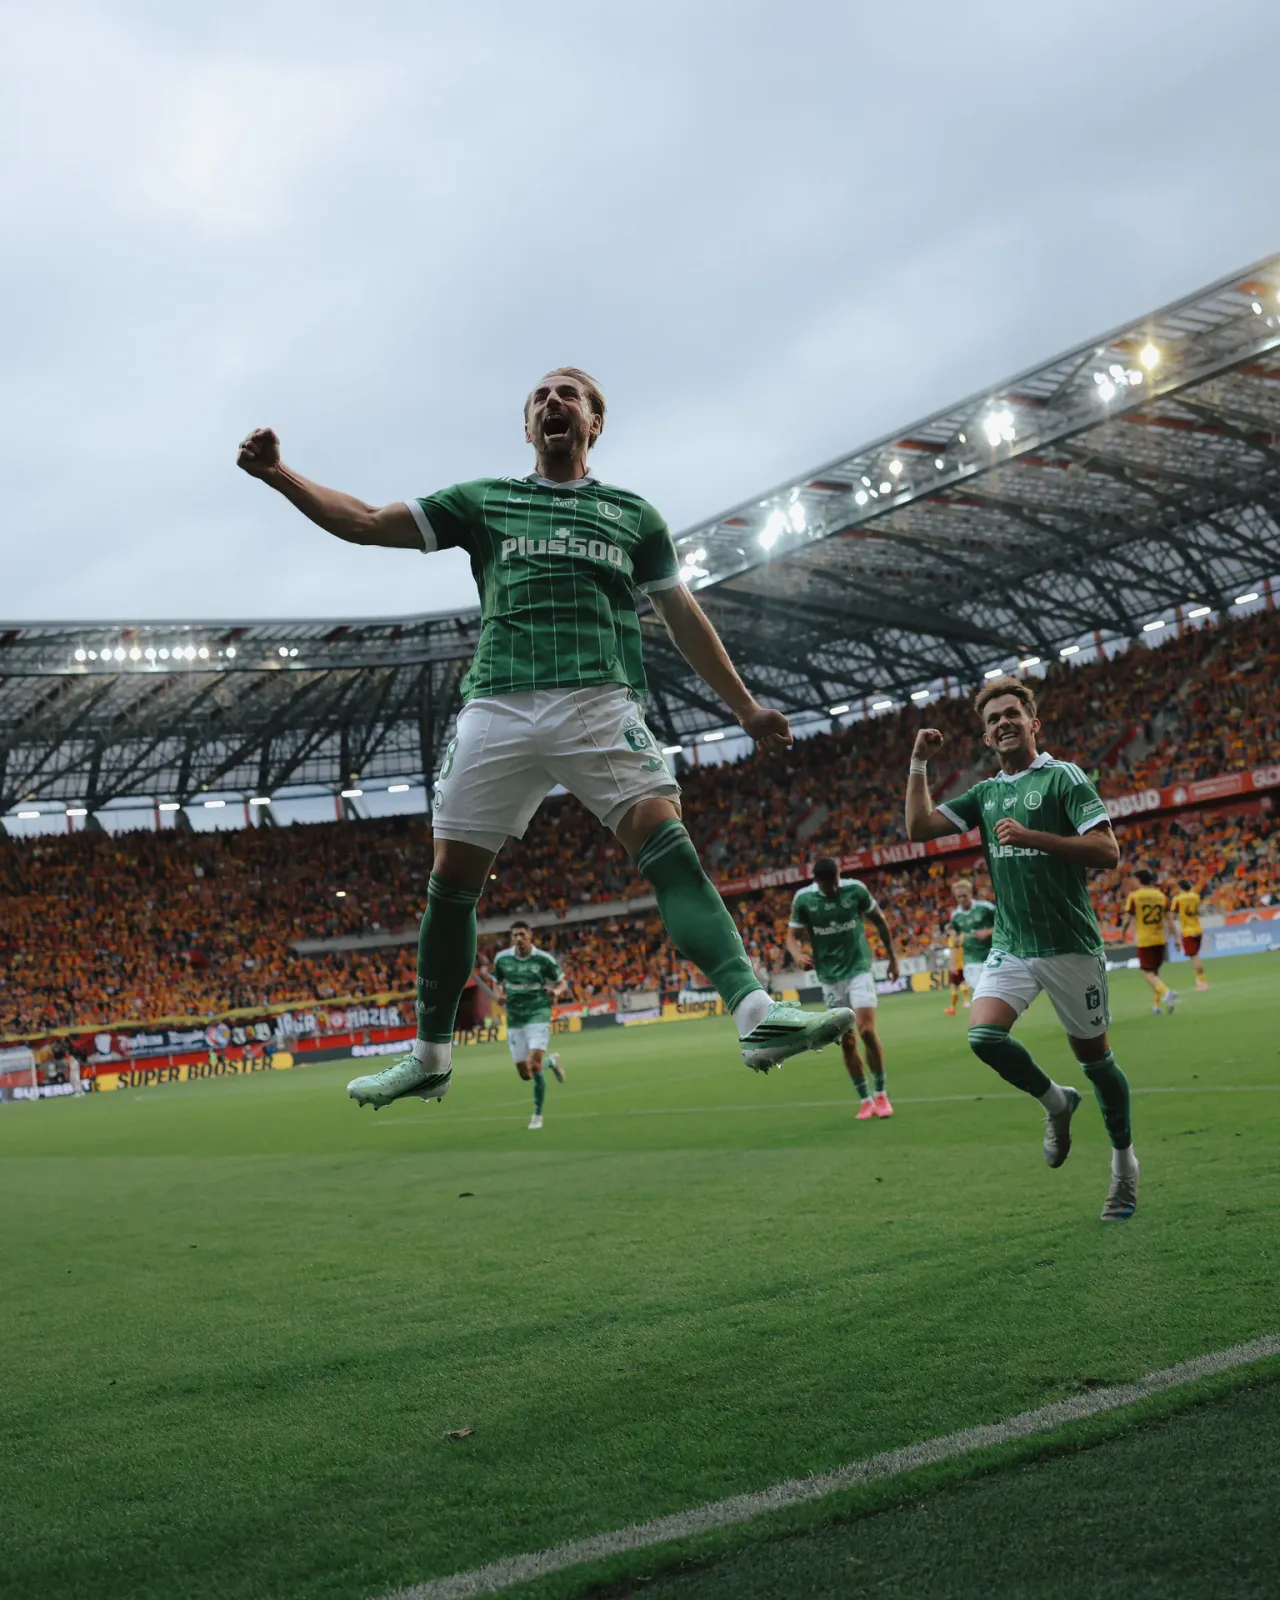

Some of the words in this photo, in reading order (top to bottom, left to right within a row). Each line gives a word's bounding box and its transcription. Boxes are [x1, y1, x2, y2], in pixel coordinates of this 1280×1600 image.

[501, 535, 624, 567] Plus500
[440, 737, 459, 780] 8
[1142, 904, 1162, 925] 23
[417, 975, 439, 989] 916
[118, 1066, 181, 1089] SUPER
[187, 1055, 274, 1081] BOOSTER
